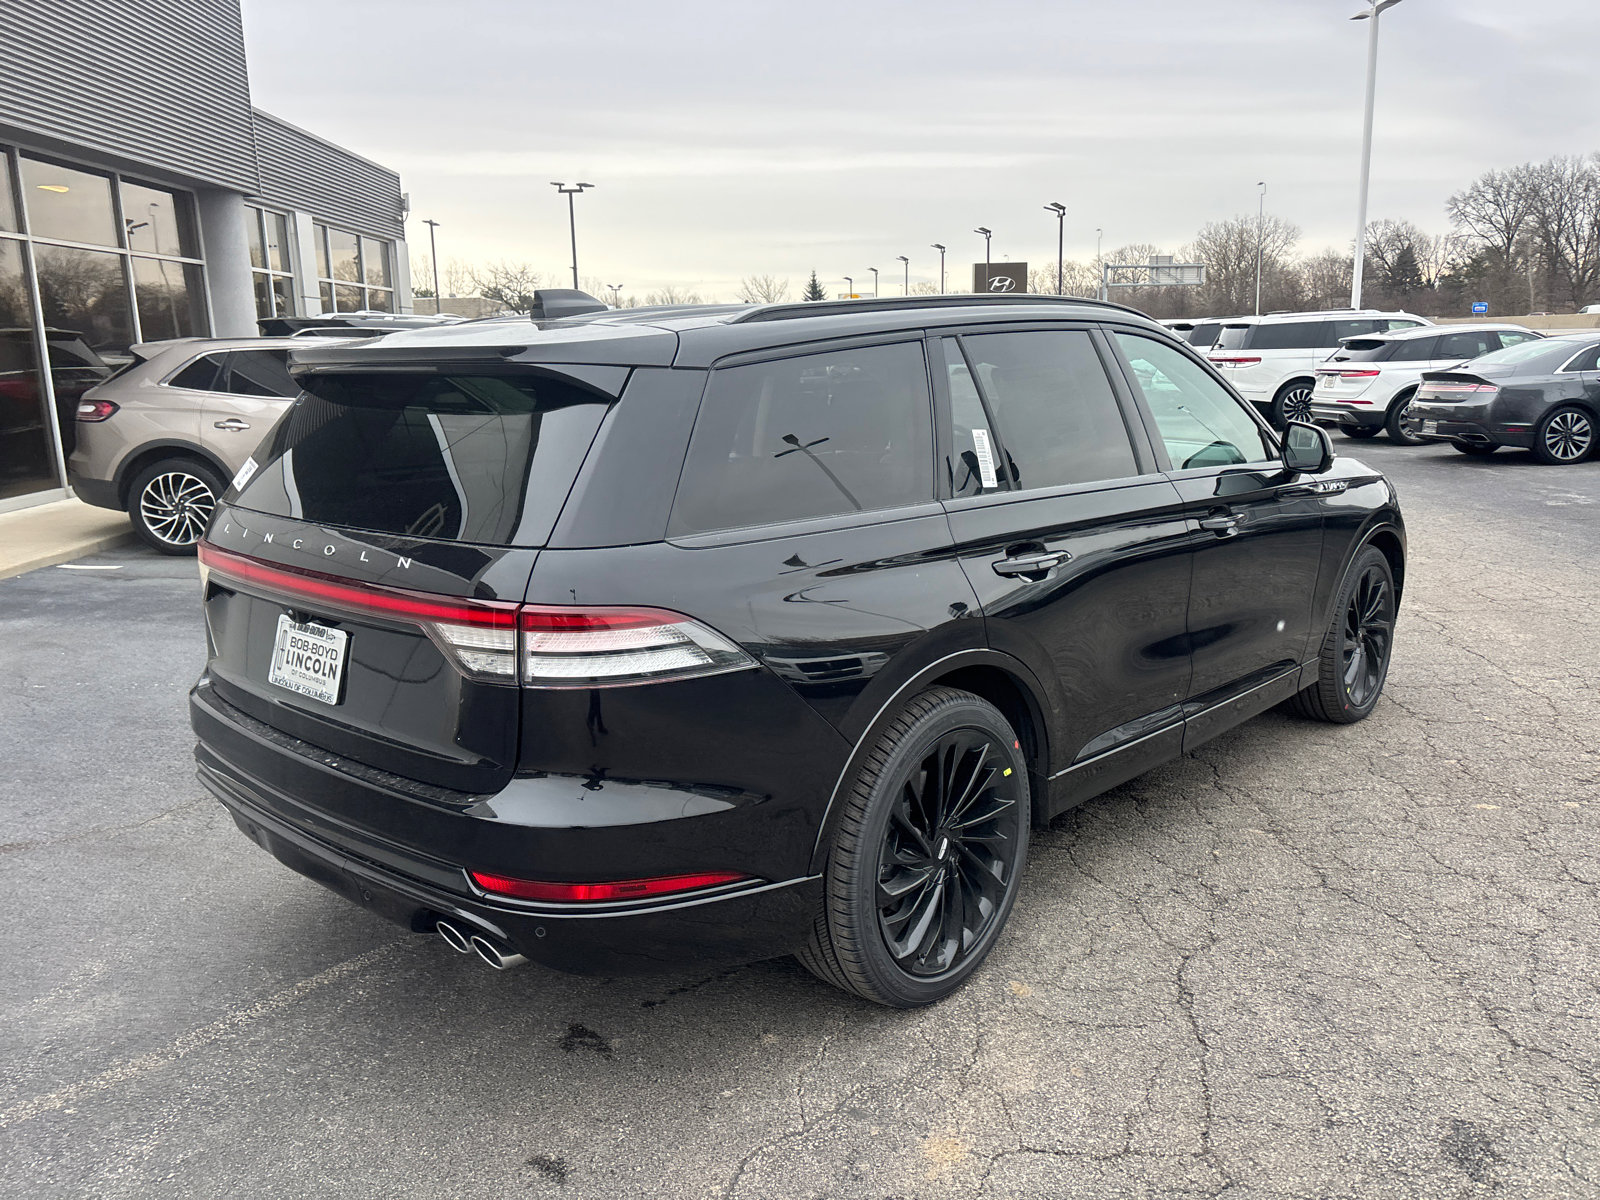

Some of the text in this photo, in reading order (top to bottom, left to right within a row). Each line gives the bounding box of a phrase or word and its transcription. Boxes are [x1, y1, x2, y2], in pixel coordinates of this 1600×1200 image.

[224, 523, 412, 569] LINCOLN
[290, 636, 338, 661] BOB-BOYD
[285, 649, 338, 681] LINCOLN
